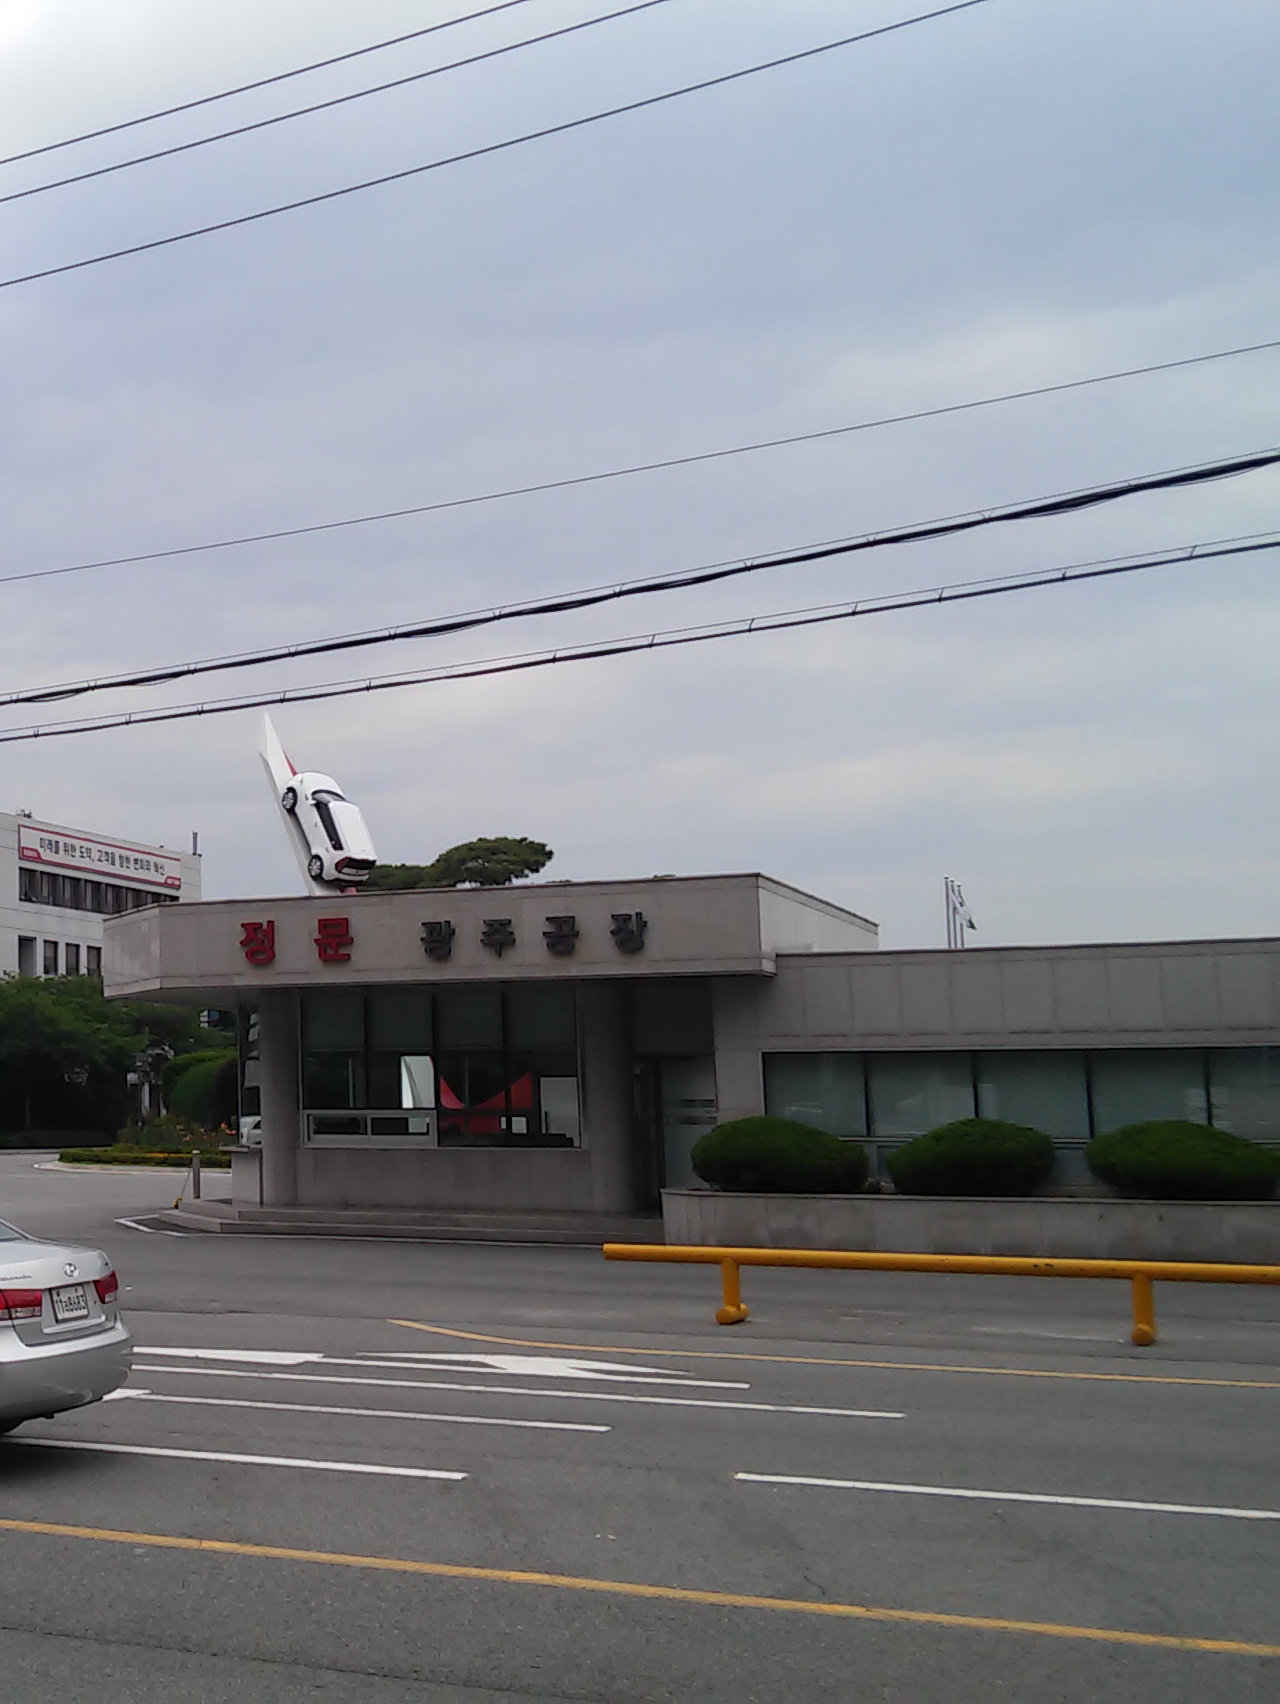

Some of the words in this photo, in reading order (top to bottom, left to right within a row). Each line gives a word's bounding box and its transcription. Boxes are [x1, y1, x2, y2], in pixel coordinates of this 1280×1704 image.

[39, 837, 60, 855] 미래를
[63, 841, 77, 857] 위한
[239, 917, 354, 966] 정문
[419, 911, 648, 960] 광주공장
